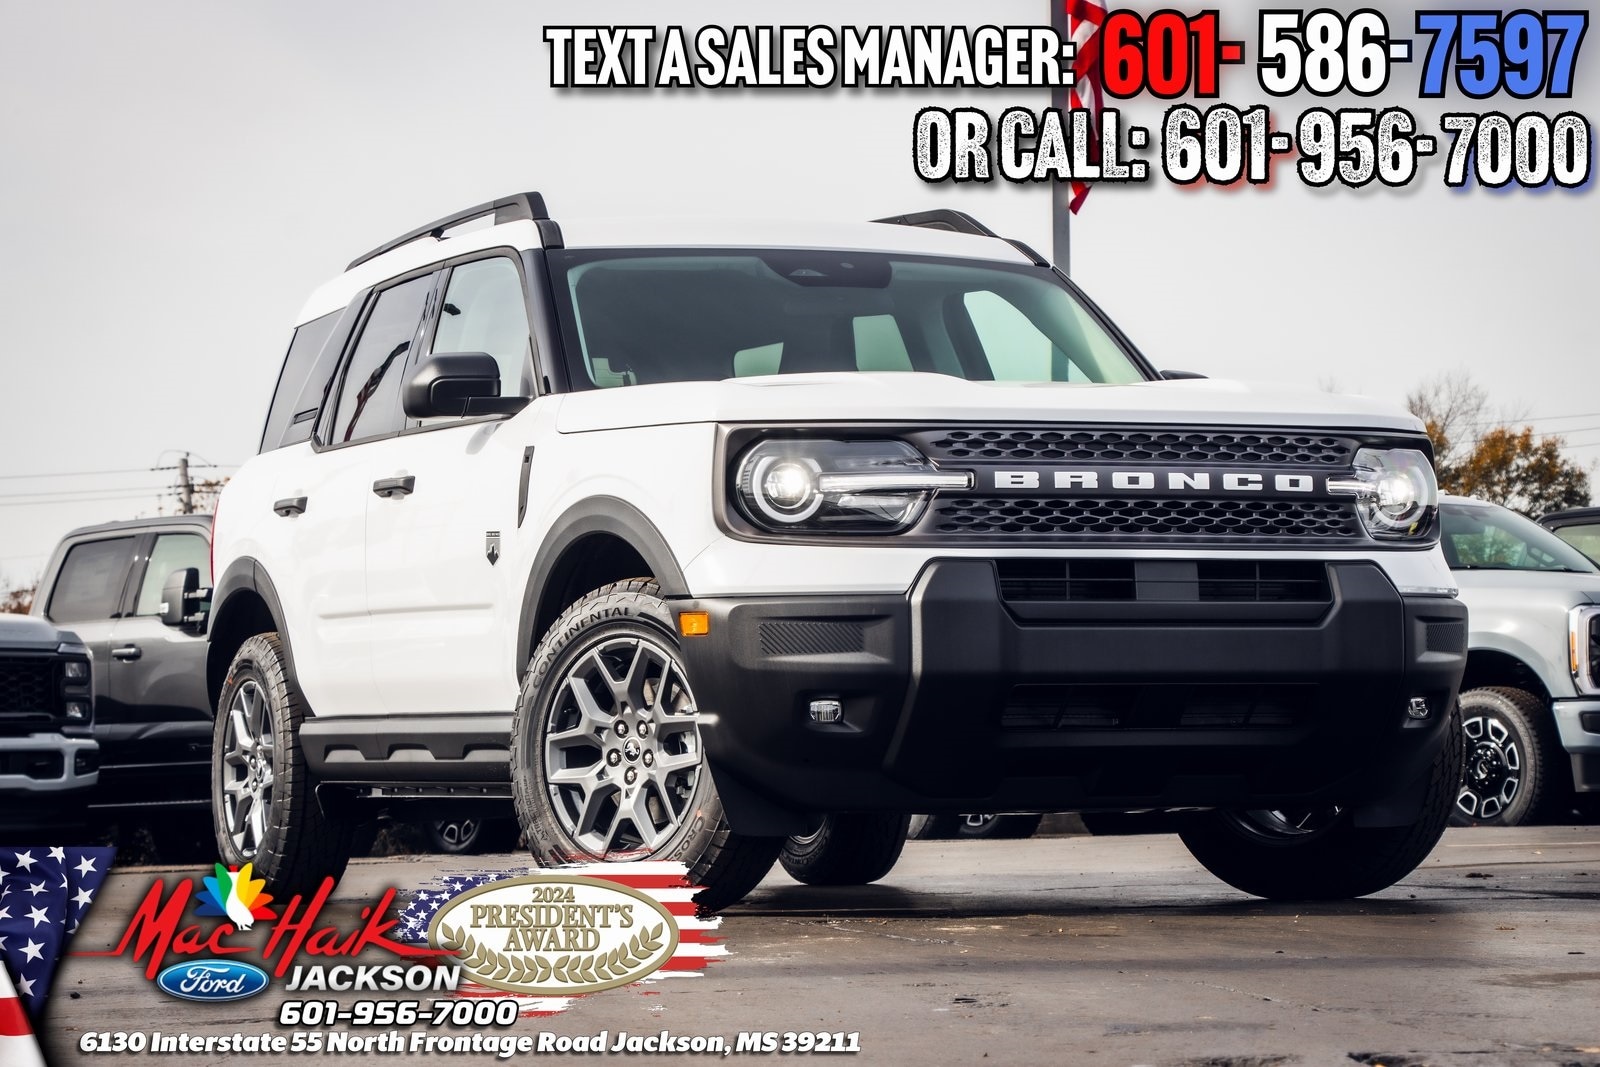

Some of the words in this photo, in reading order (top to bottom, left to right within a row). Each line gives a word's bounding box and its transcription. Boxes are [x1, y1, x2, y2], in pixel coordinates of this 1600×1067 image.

[994, 470, 1314, 493] BRONCO
[532, 606, 634, 689] CONTINENTAL
[672, 815, 706, 862] CROS
